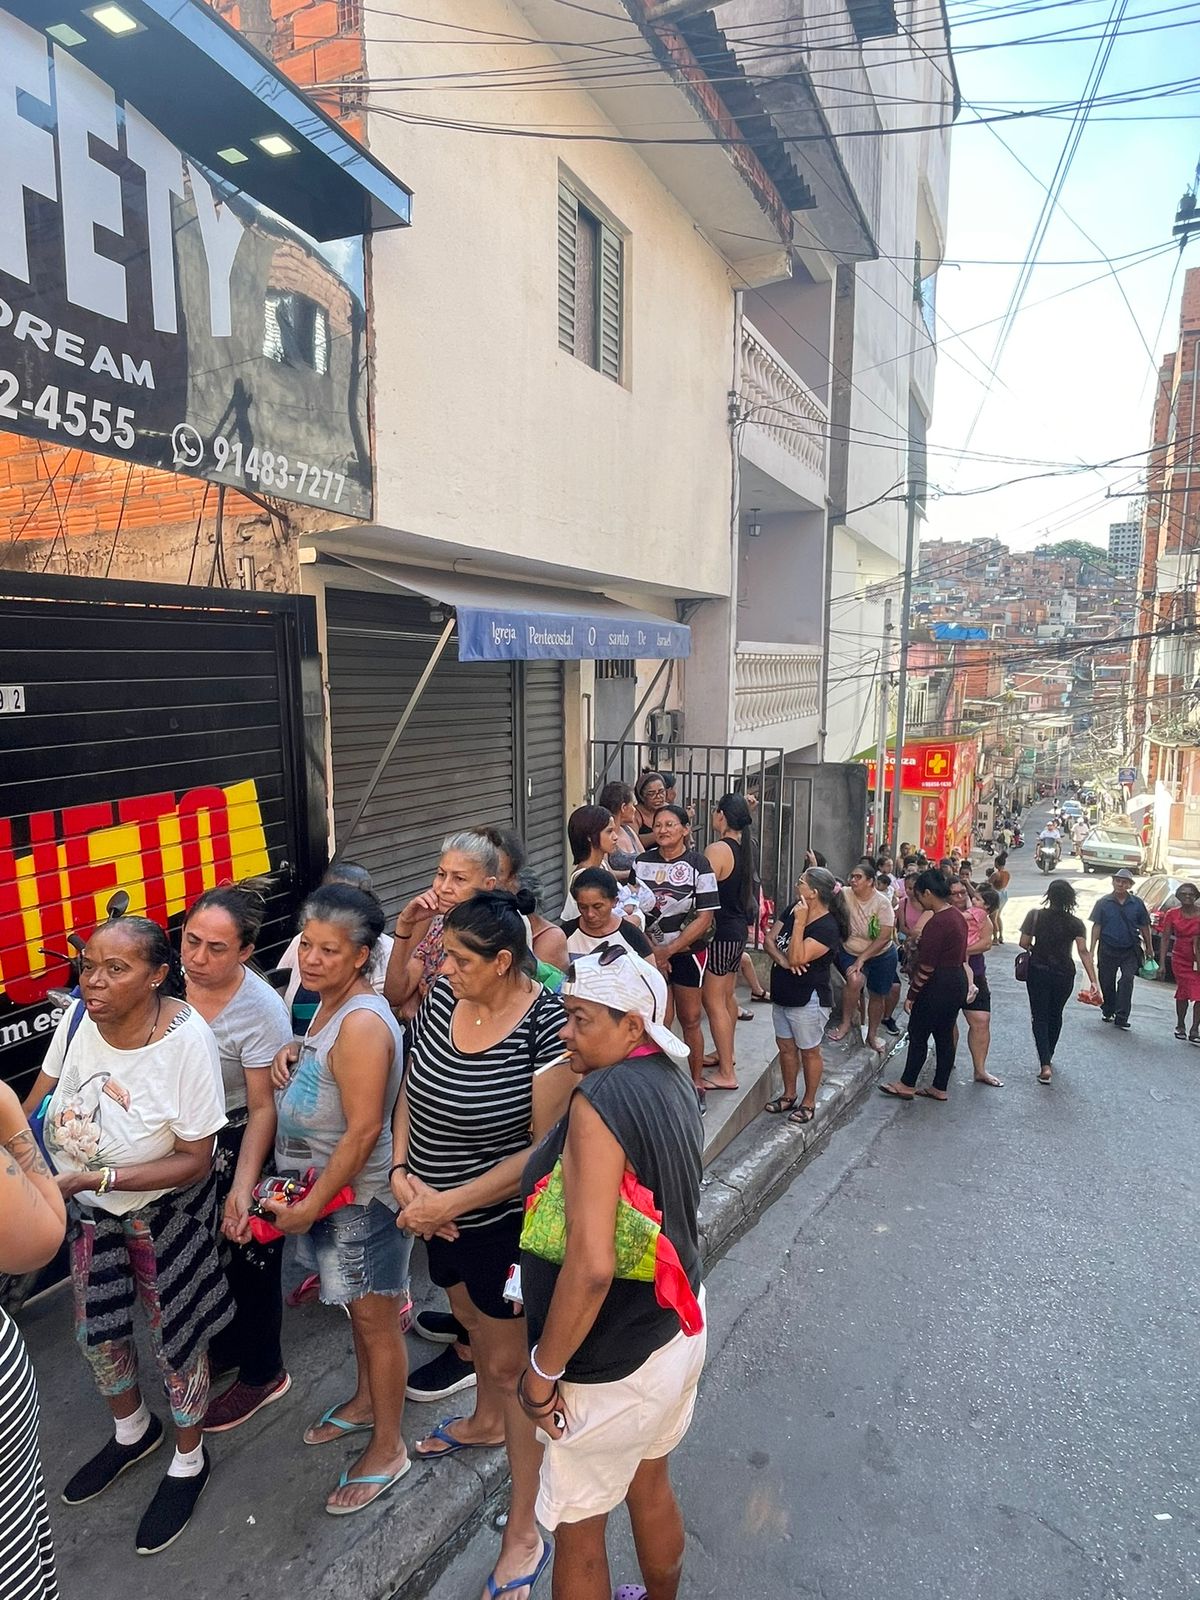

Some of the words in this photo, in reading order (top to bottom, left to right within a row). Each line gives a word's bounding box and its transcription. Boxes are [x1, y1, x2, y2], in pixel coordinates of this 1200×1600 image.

[0, 369, 135, 450] 2-4555
[213, 435, 345, 504] 91483-7277
[492, 621, 516, 645] Igreja
[529, 626, 574, 646] Pentecostal
[588, 626, 597, 647] O
[608, 629, 630, 647] santo
